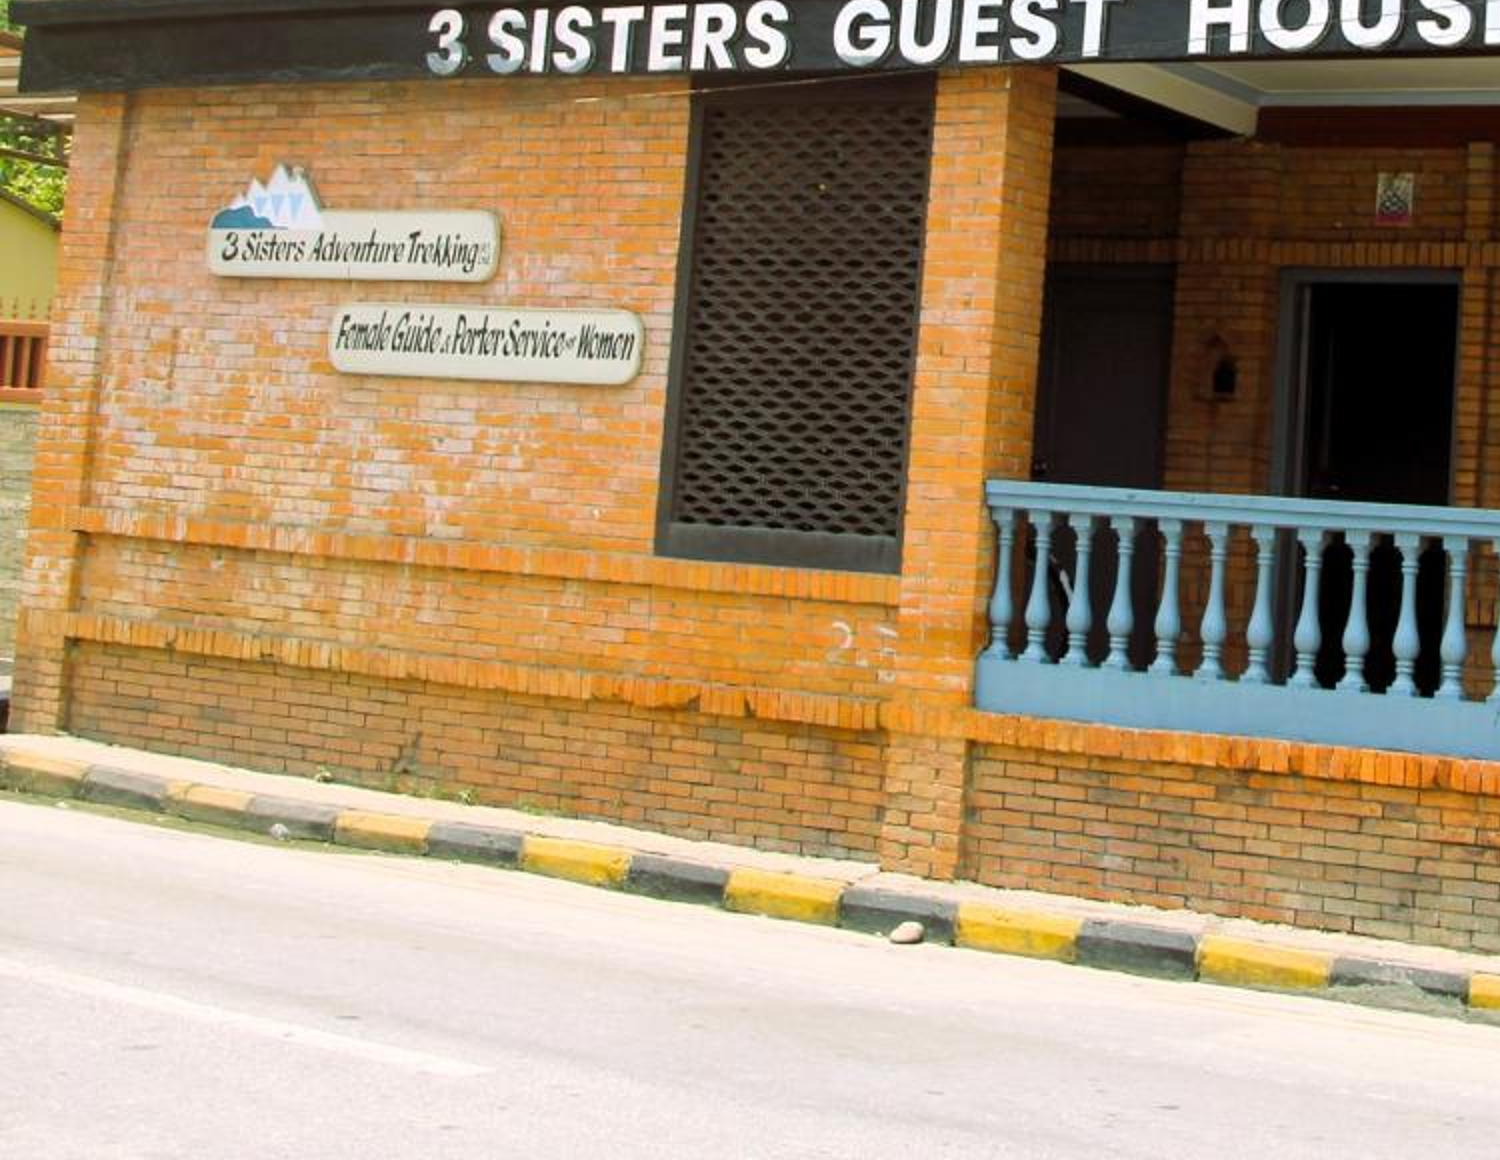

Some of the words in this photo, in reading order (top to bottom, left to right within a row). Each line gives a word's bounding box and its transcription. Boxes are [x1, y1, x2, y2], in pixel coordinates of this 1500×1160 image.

[426, 7, 464, 76] 3
[221, 231, 239, 262] 3
[241, 231, 306, 263] Sisters
[309, 227, 405, 265] Adventure
[407, 230, 479, 272] Trekking
[335, 310, 391, 352] Female
[391, 311, 443, 354] Guide
[451, 314, 505, 356] Porter
[503, 319, 568, 359] Service
[576, 323, 635, 361] Women
